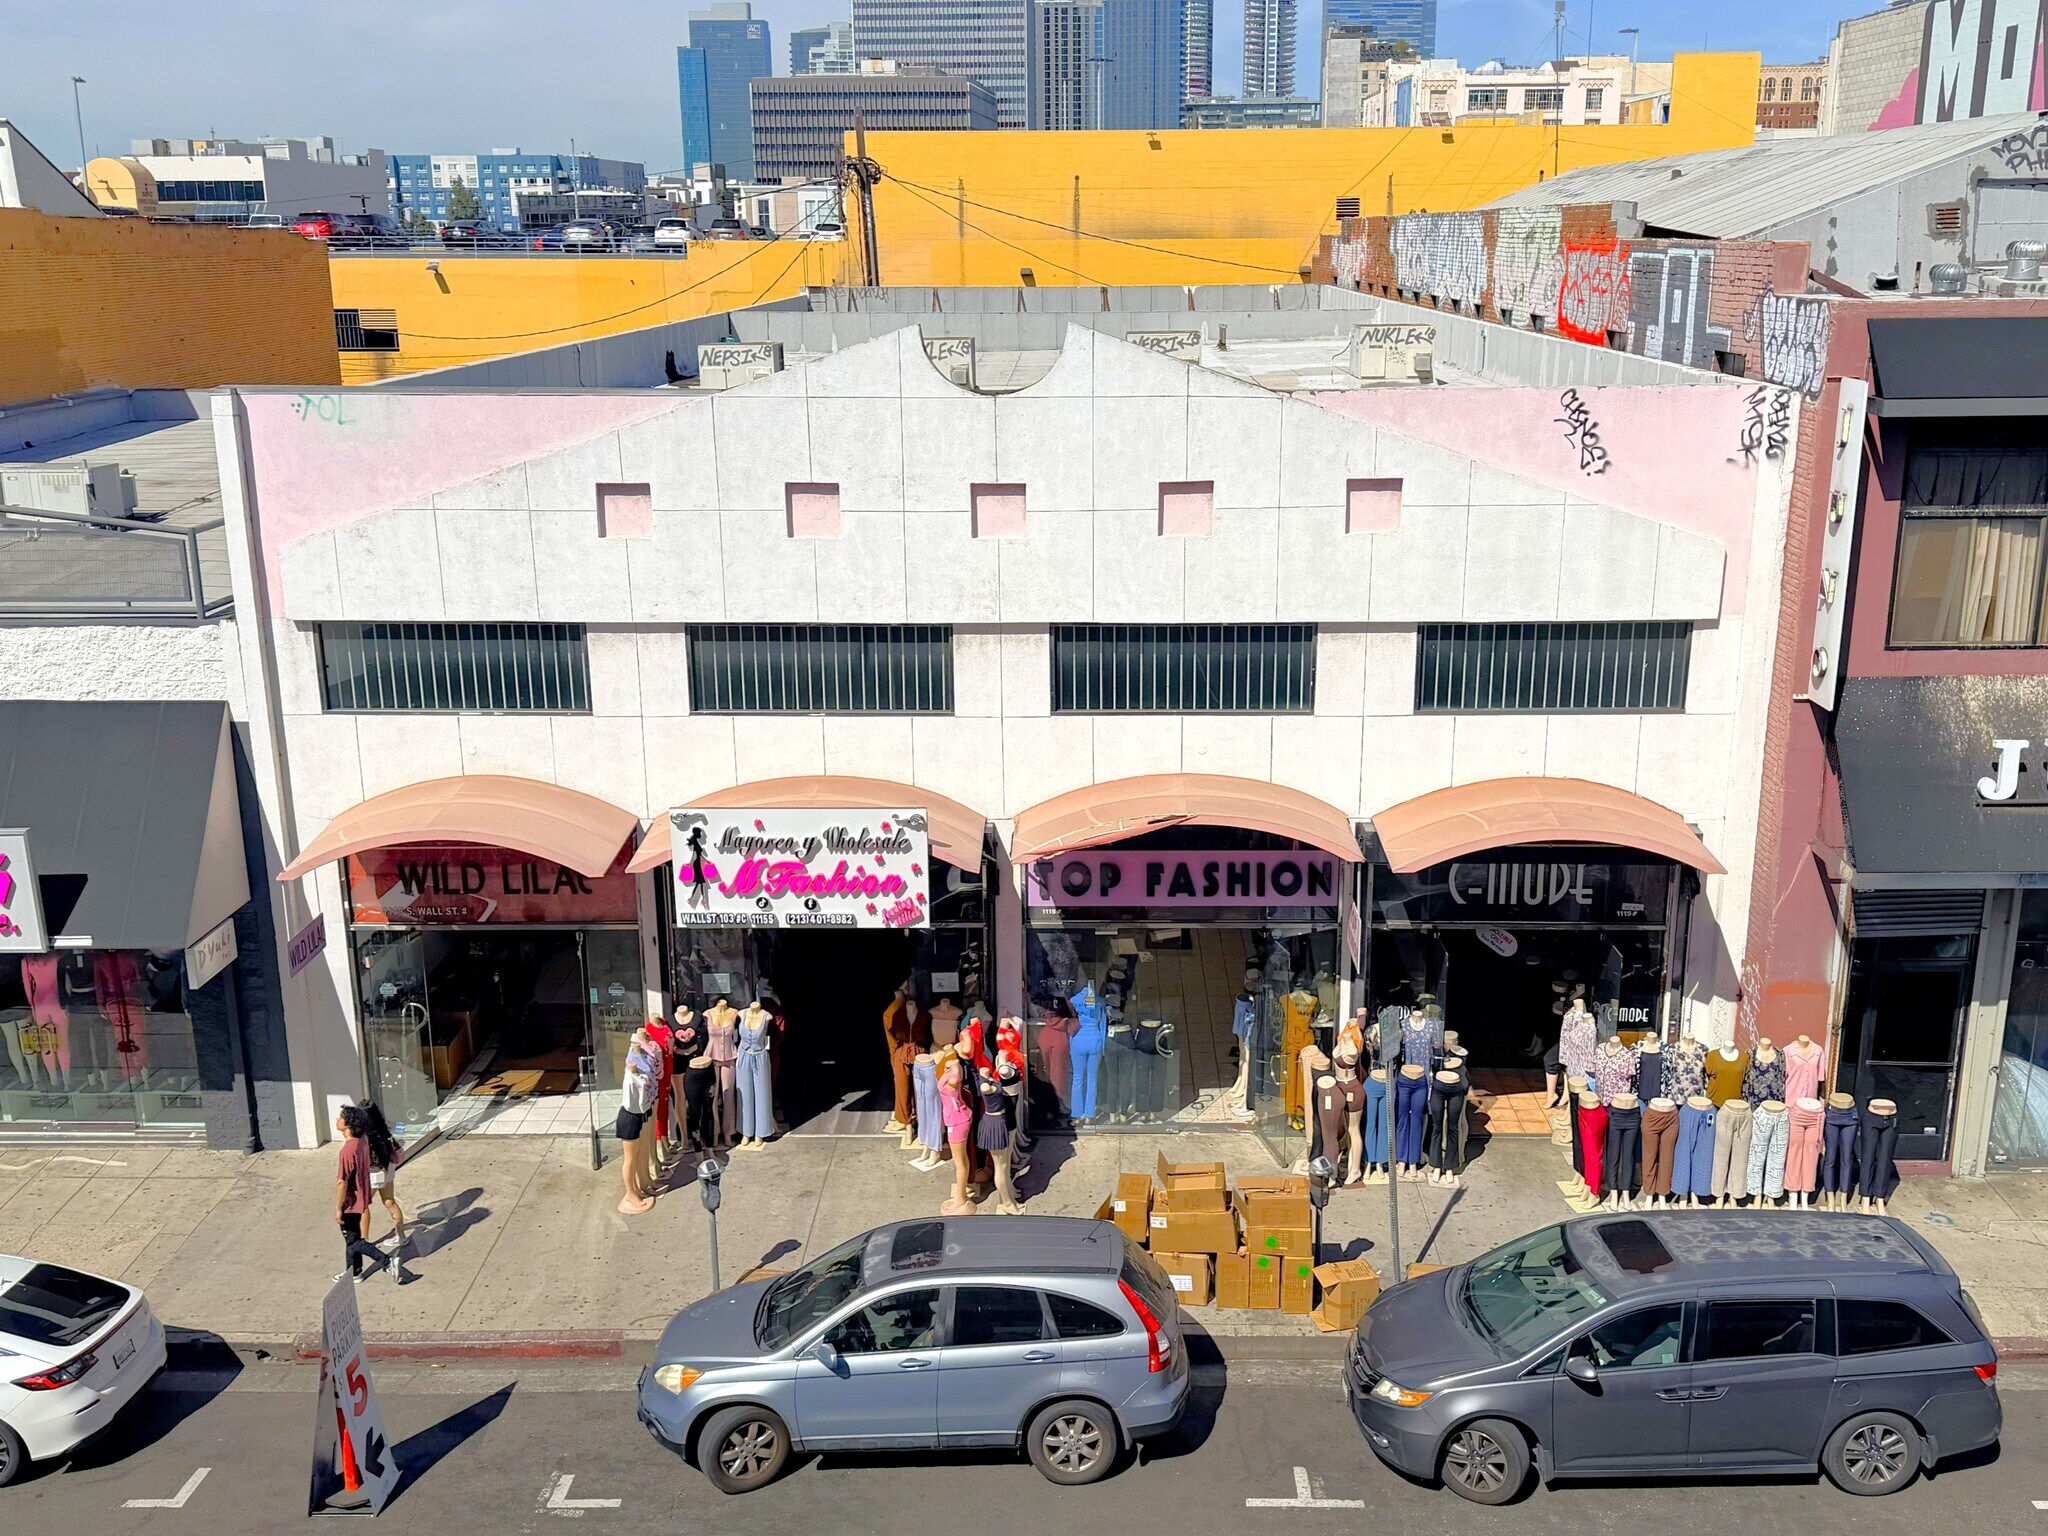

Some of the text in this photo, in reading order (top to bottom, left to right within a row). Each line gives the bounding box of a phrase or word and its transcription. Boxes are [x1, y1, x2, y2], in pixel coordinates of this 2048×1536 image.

[1922, 0, 2048, 125] MO
[1360, 327, 1416, 345] NUKLE
[700, 347, 752, 367] NEPSI
[1976, 739, 2048, 801] J
[714, 826, 909, 859] Mayoreo y Wholesale
[397, 862, 486, 895] WILD
[1033, 861, 1332, 900] TOP FASHION
[418, 907, 443, 916] WALL
[446, 907, 459, 916] ST.
[289, 940, 306, 969] WILD
[1607, 1007, 1650, 1023] C-MODE
[331, 1299, 355, 1343] PUBLIC
[331, 1317, 361, 1368] PARKING
[345, 1353, 368, 1418] 5
